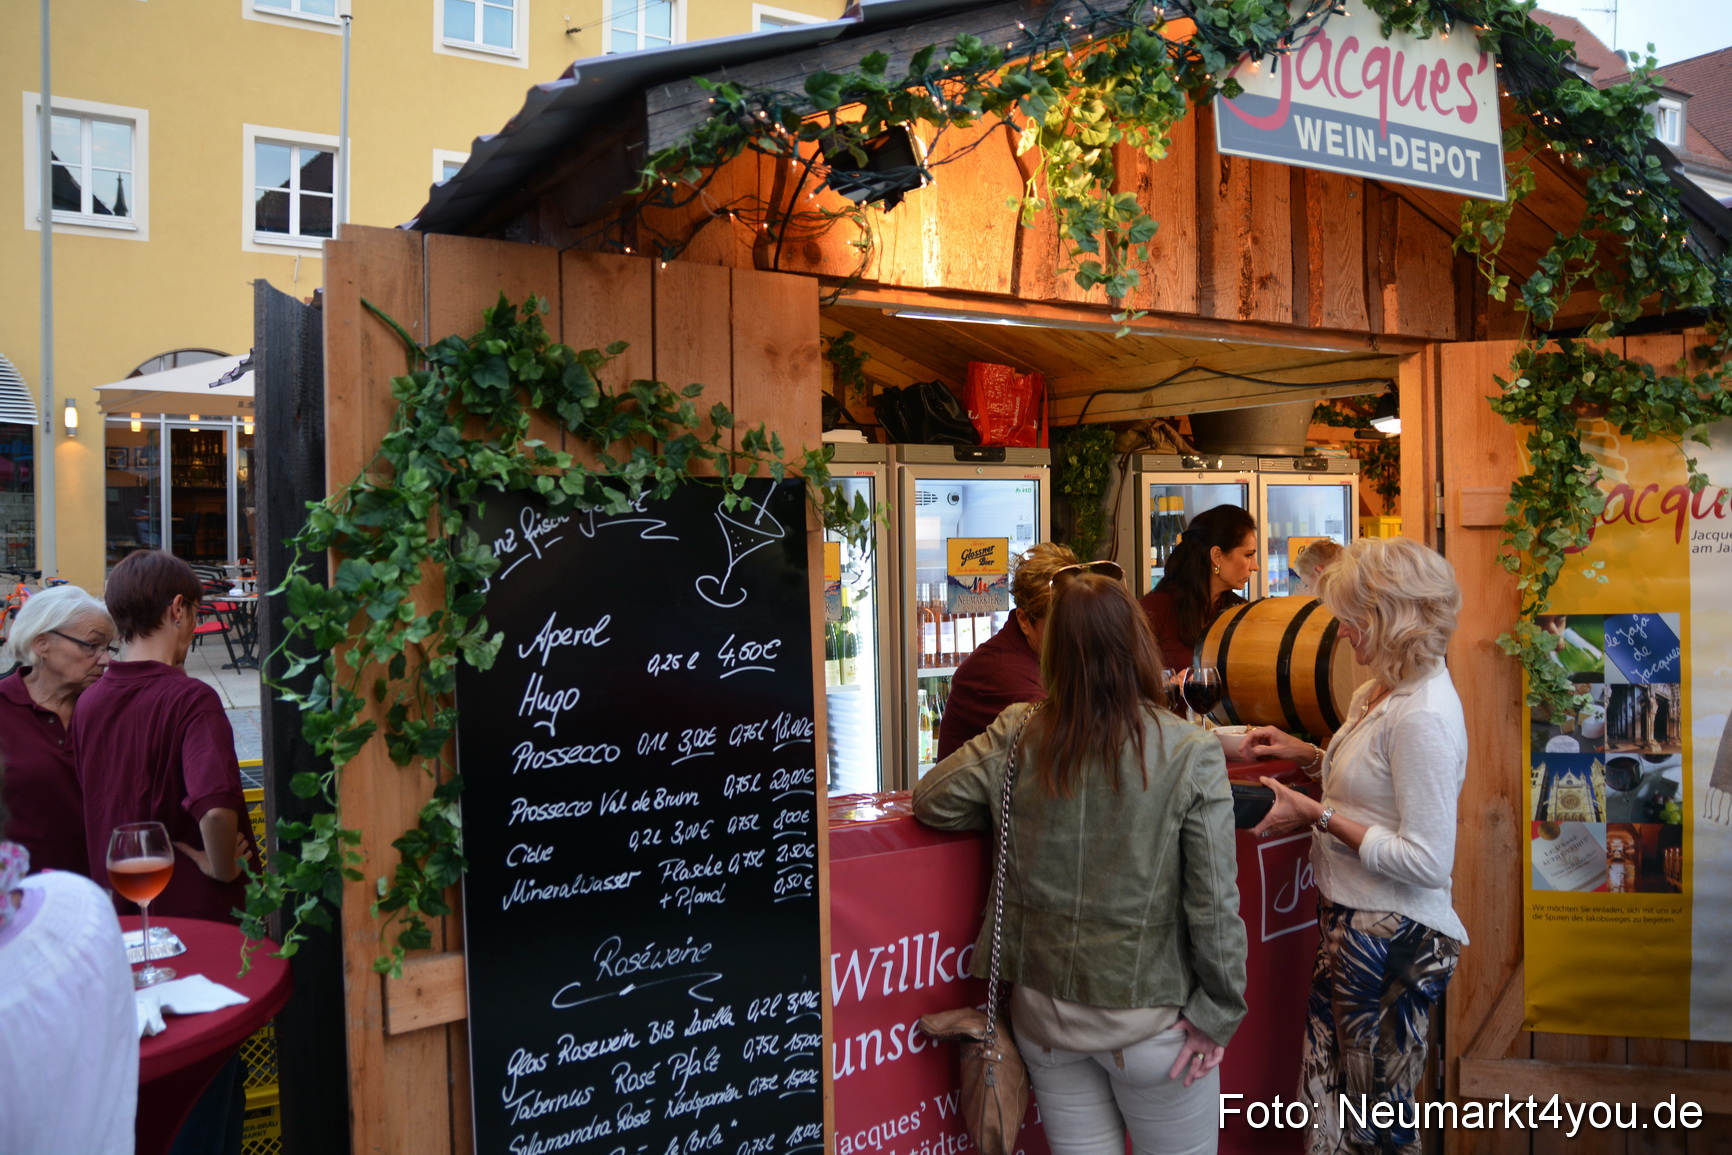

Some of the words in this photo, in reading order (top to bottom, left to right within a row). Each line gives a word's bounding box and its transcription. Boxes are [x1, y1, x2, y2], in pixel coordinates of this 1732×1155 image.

[1294, 114, 1481, 181] WEIN-DEPOT
[961, 545, 995, 567] Glossner
[979, 557, 995, 566] Bier
[1692, 545, 1712, 553] am
[519, 611, 611, 667] Aperol
[647, 654, 683, 677] 0,25
[717, 633, 782, 667] 4,50€
[1633, 646, 1652, 661] de
[1631, 646, 1680, 684] Jacques
[518, 672, 580, 737] Hugo
[512, 741, 621, 775] Prossecco
[678, 726, 717, 756] 3,00€
[729, 719, 769, 747] 0,75l
[771, 711, 814, 743] 18,00€
[508, 797, 593, 826] Prossecco
[600, 789, 627, 816] Val
[631, 790, 651, 812] de
[723, 773, 761, 799] 0,75l
[769, 768, 815, 791] 20,00€
[629, 828, 662, 852] 0,2l
[670, 819, 714, 845] 3,00€
[727, 813, 760, 834] 0,75l
[773, 809, 810, 830] 8,00€
[658, 854, 723, 884] Flasche
[728, 849, 765, 874] 0,75l
[776, 844, 815, 862] 2,50€
[675, 883, 726, 914] Pfand
[773, 873, 814, 895] 0,50€
[1547, 905, 1578, 913] möchten
[1580, 905, 1590, 913] Sie
[1627, 906, 1640, 914] sich
[1642, 906, 1654, 914] mit
[1545, 914, 1569, 922] Spuren
[1585, 915, 1631, 924] Jakobsweges
[594, 936, 712, 981] Roséweine
[502, 1048, 549, 1103] Glas
[557, 1028, 641, 1066] Rosewein
[648, 1019, 674, 1044] BIB
[747, 993, 782, 1023] 0,2l
[787, 990, 820, 1014] 3,00€
[611, 1062, 661, 1094] Rosé
[667, 1046, 721, 1097] Pfalz
[743, 1035, 779, 1063] 0,75l
[832, 1018, 938, 1081] unse
[748, 1074, 778, 1097] 0,75l
